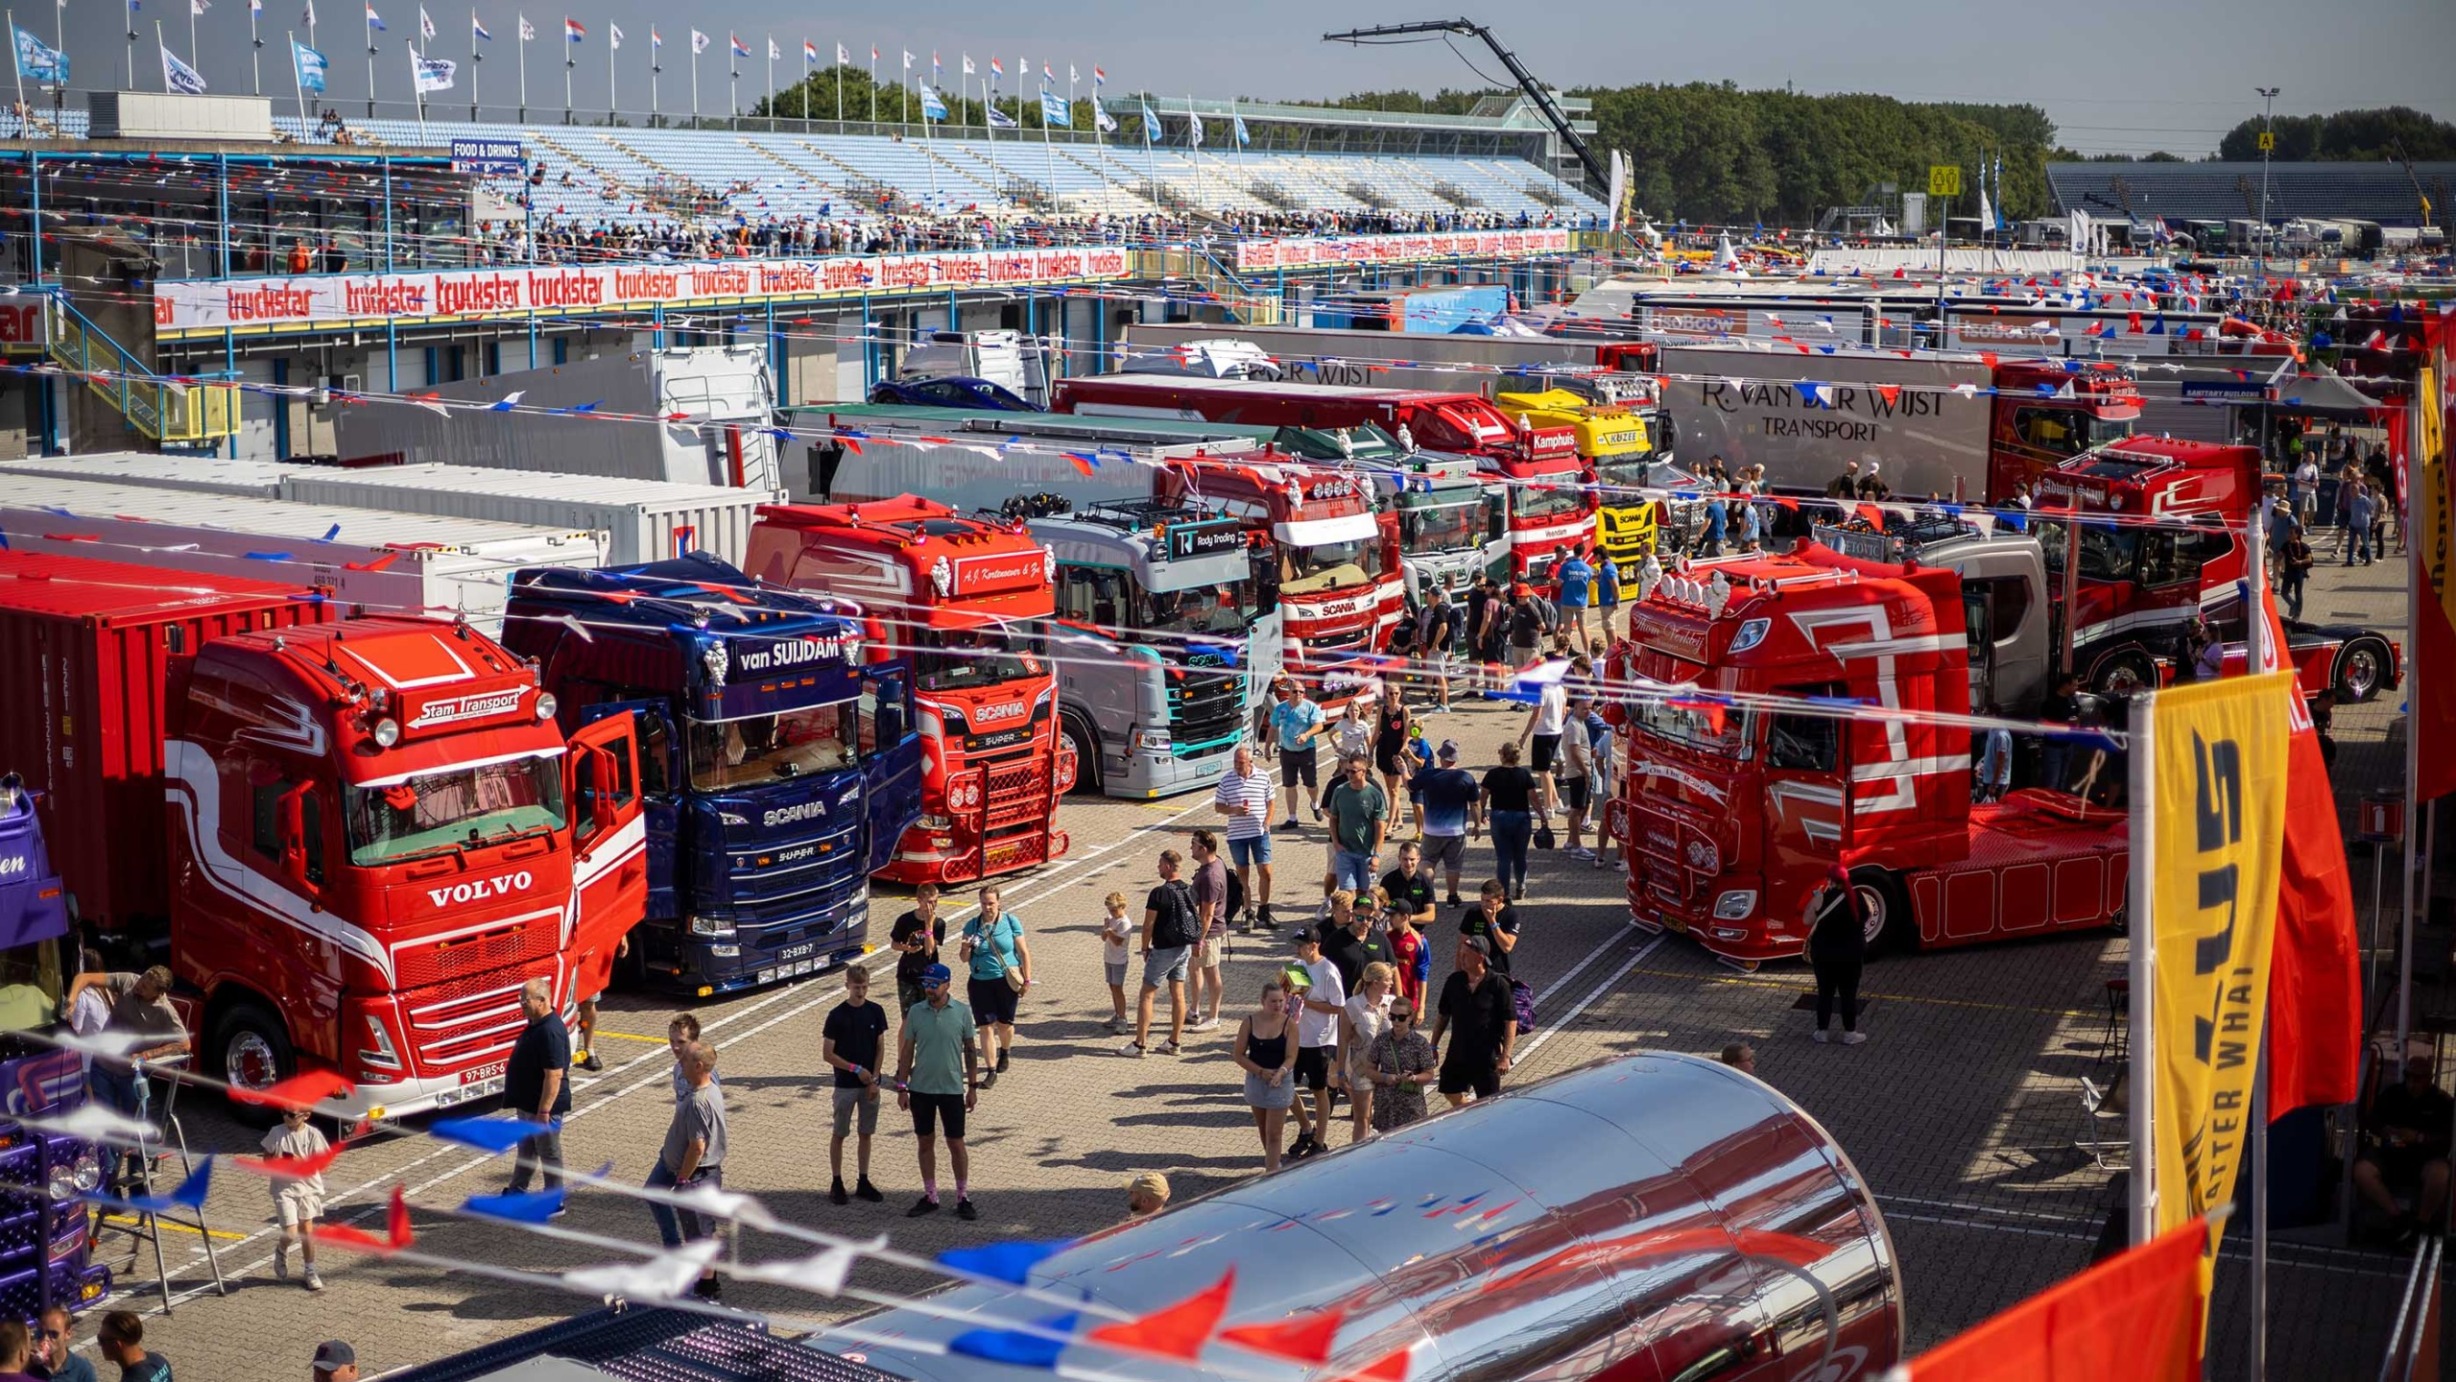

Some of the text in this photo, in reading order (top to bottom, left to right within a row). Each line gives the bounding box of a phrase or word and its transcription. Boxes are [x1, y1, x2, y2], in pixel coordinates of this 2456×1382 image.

[454, 143, 519, 157] FOOD & DRINKS
[2262, 136, 2270, 147] A
[227, 283, 312, 319] truckstar
[345, 279, 425, 314] truckstar
[435, 273, 520, 311] truckstar
[528, 269, 604, 308] truckstar
[616, 267, 678, 299] truckstar
[692, 264, 750, 295] truckstar
[760, 262, 815, 292] truckstar
[1702, 373, 1739, 413] R.
[1739, 383, 1792, 409] VAN
[1866, 381, 1947, 418] WIJST
[2186, 389, 2260, 398] SANITARY BUILDING
[1762, 417, 1880, 442] TRANSPORT
[1534, 432, 1575, 450] Kamphuis
[1620, 514, 1642, 524] SCANIA
[1197, 535, 1213, 547] Rody
[1214, 533, 1236, 544] Trading
[1322, 602, 1357, 616] SCANIA
[741, 635, 840, 671] van SUIJDAM
[420, 701, 455, 720] Stam
[460, 692, 520, 713] Transport
[975, 702, 1025, 722] SCANIA
[985, 734, 1015, 746] SUPER
[1649, 767, 1662, 775] On
[1665, 767, 1680, 778] The
[763, 801, 826, 827] SCANIA
[778, 846, 815, 862] SUPER
[427, 871, 532, 907] VOLVO
[465, 1062, 506, 1082] 97-BRS-6
[2205, 1089, 2243, 1209] ATTER
